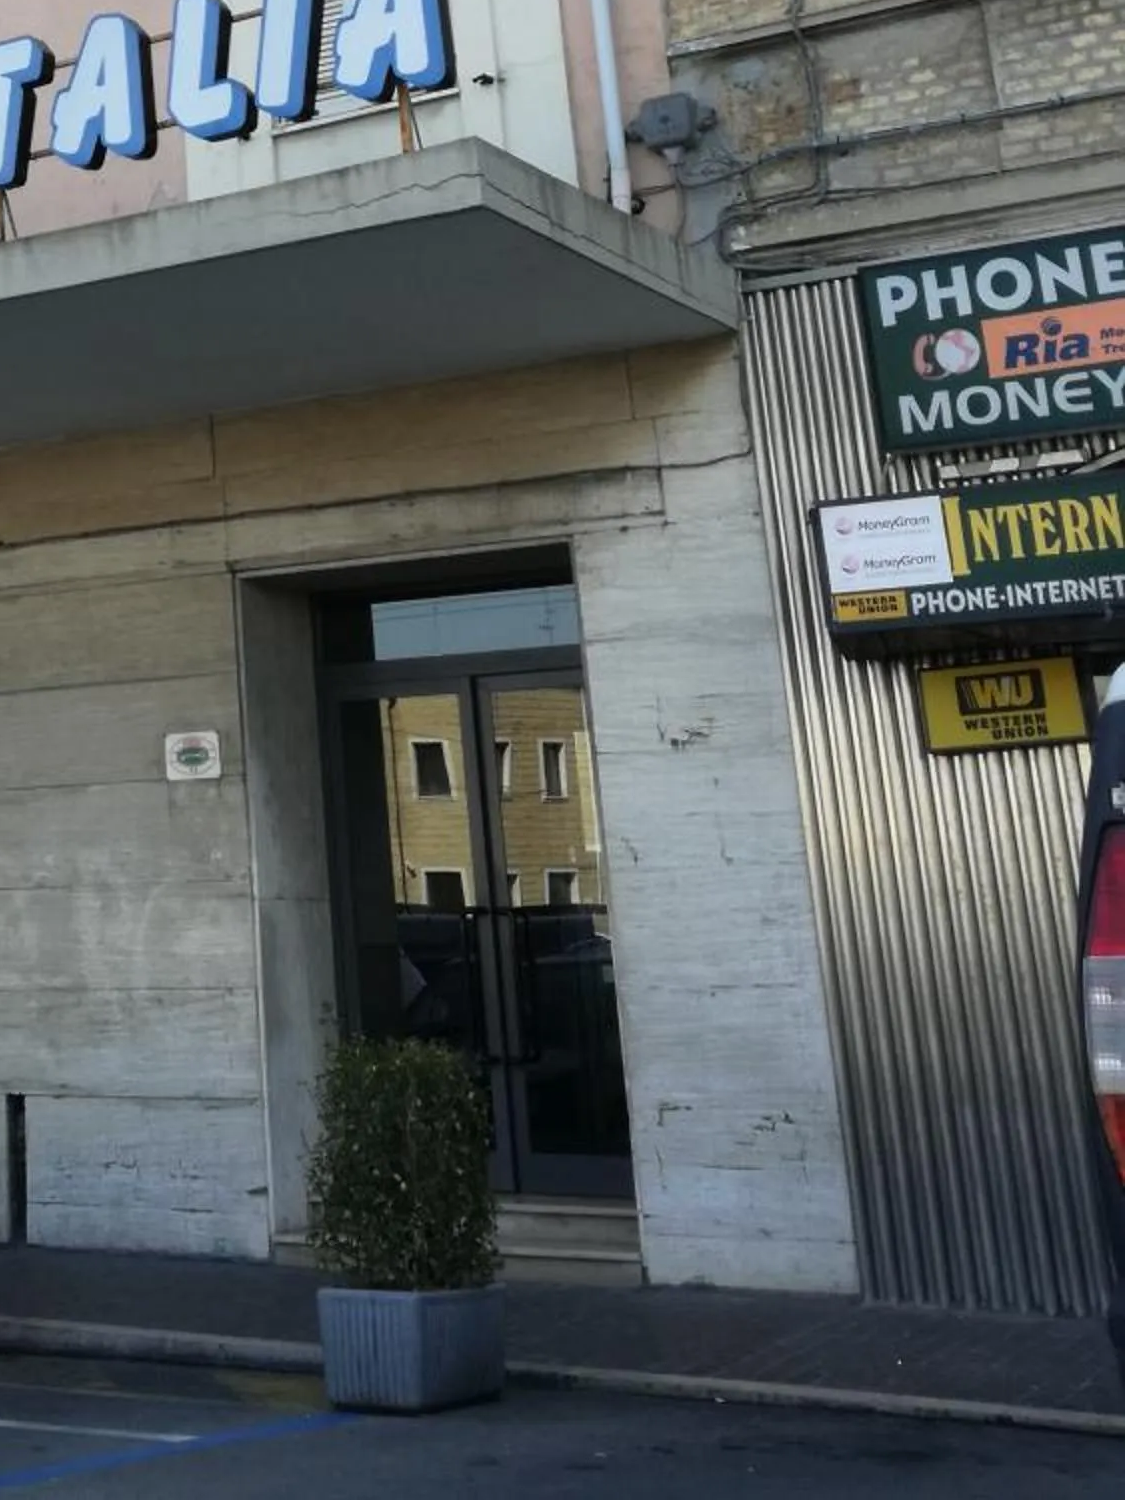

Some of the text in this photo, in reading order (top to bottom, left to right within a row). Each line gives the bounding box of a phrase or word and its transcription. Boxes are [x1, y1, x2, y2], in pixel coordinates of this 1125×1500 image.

[876, 241, 1125, 328] PHONE
[1004, 317, 1090, 370] Ria
[898, 364, 1125, 435] MONEY
[858, 514, 930, 531] MoneyGram
[942, 493, 1125, 577] INTERN
[864, 553, 936, 570] MoneyGram
[838, 595, 897, 608] WESTERN
[858, 604, 898, 615] UNION
[964, 712, 1046, 731] WESTERN
[992, 725, 1048, 741] UNION
